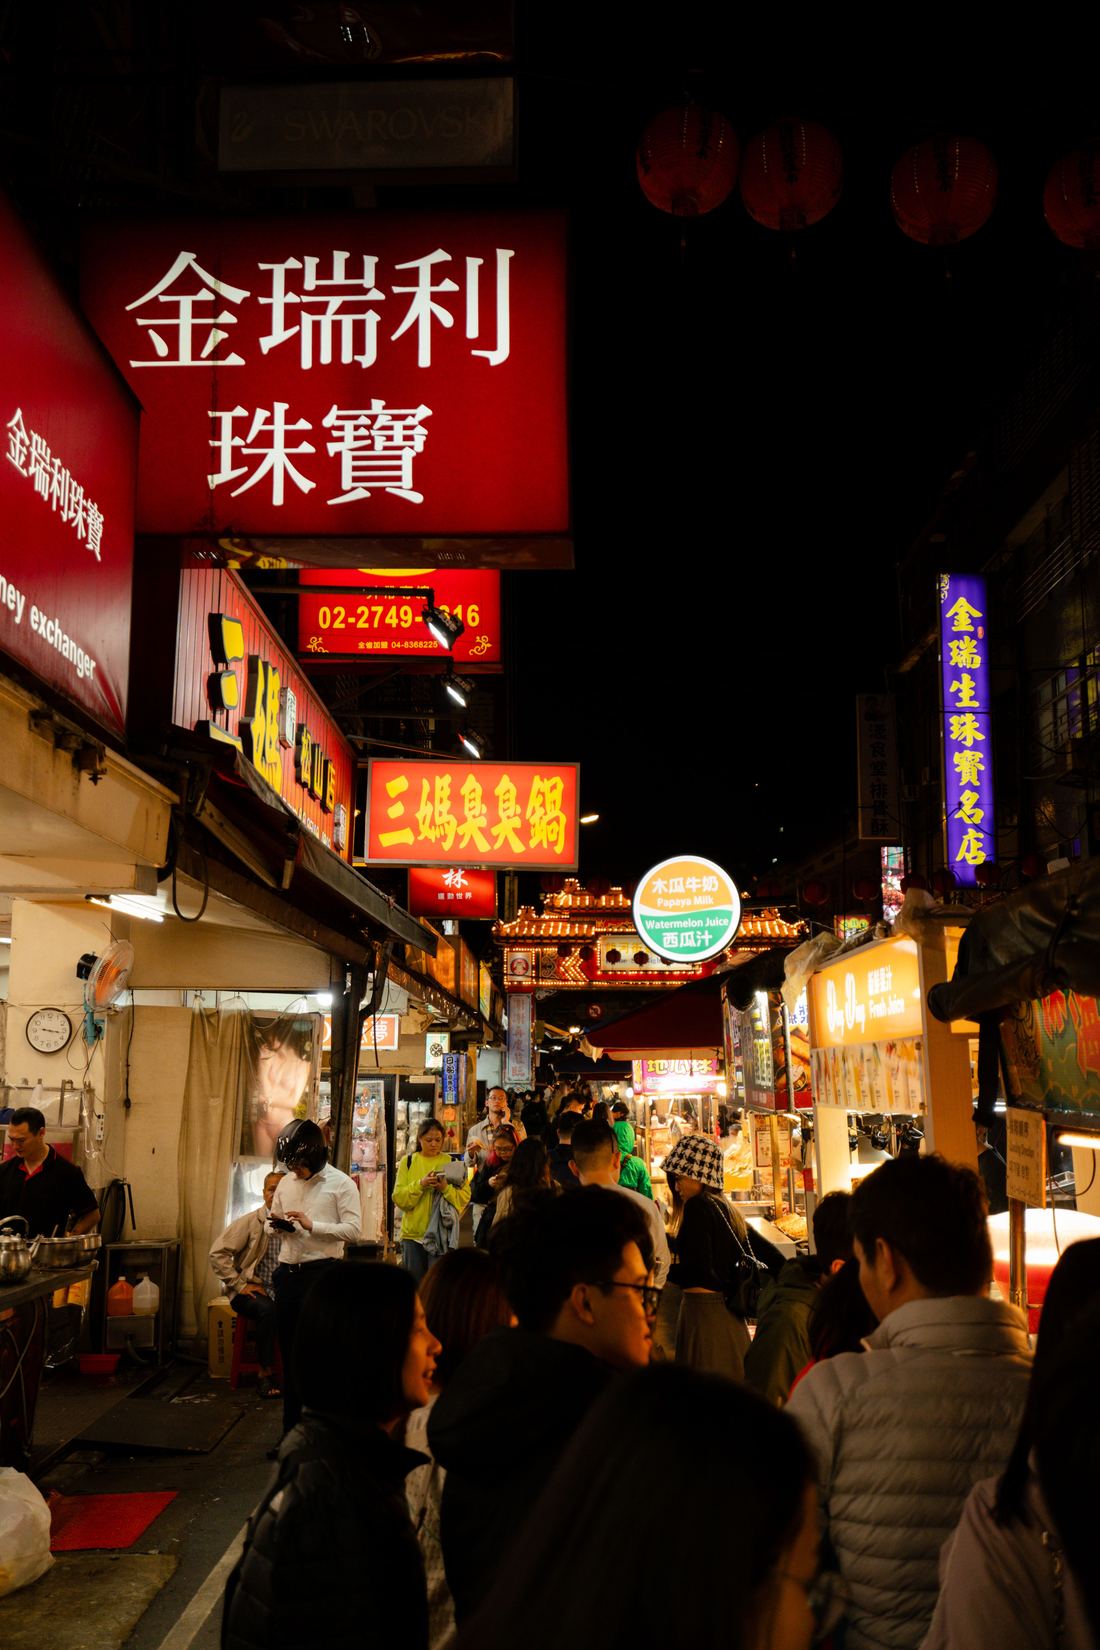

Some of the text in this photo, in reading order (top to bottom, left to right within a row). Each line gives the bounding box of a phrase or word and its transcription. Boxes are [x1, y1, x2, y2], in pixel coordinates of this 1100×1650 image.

[285, 104, 492, 142] SWAROVSK
[125, 248, 515, 369] 金瑞利
[207, 398, 433, 507] 珠寶
[6, 407, 105, 562] 金瑞利珠寶
[29, 605, 97, 681] exchanger
[318, 604, 480, 629] 02-2749-16
[945, 597, 986, 865] 金瑞生珠寶名店
[378, 773, 567, 854] 三媽臭臭鍋
[652, 875, 719, 894] 木瓜牛奶
[657, 895, 714, 909] Papaya Milk
[645, 916, 729, 929] Watermelon Juice
[662, 929, 713, 948] 西瓜汁
